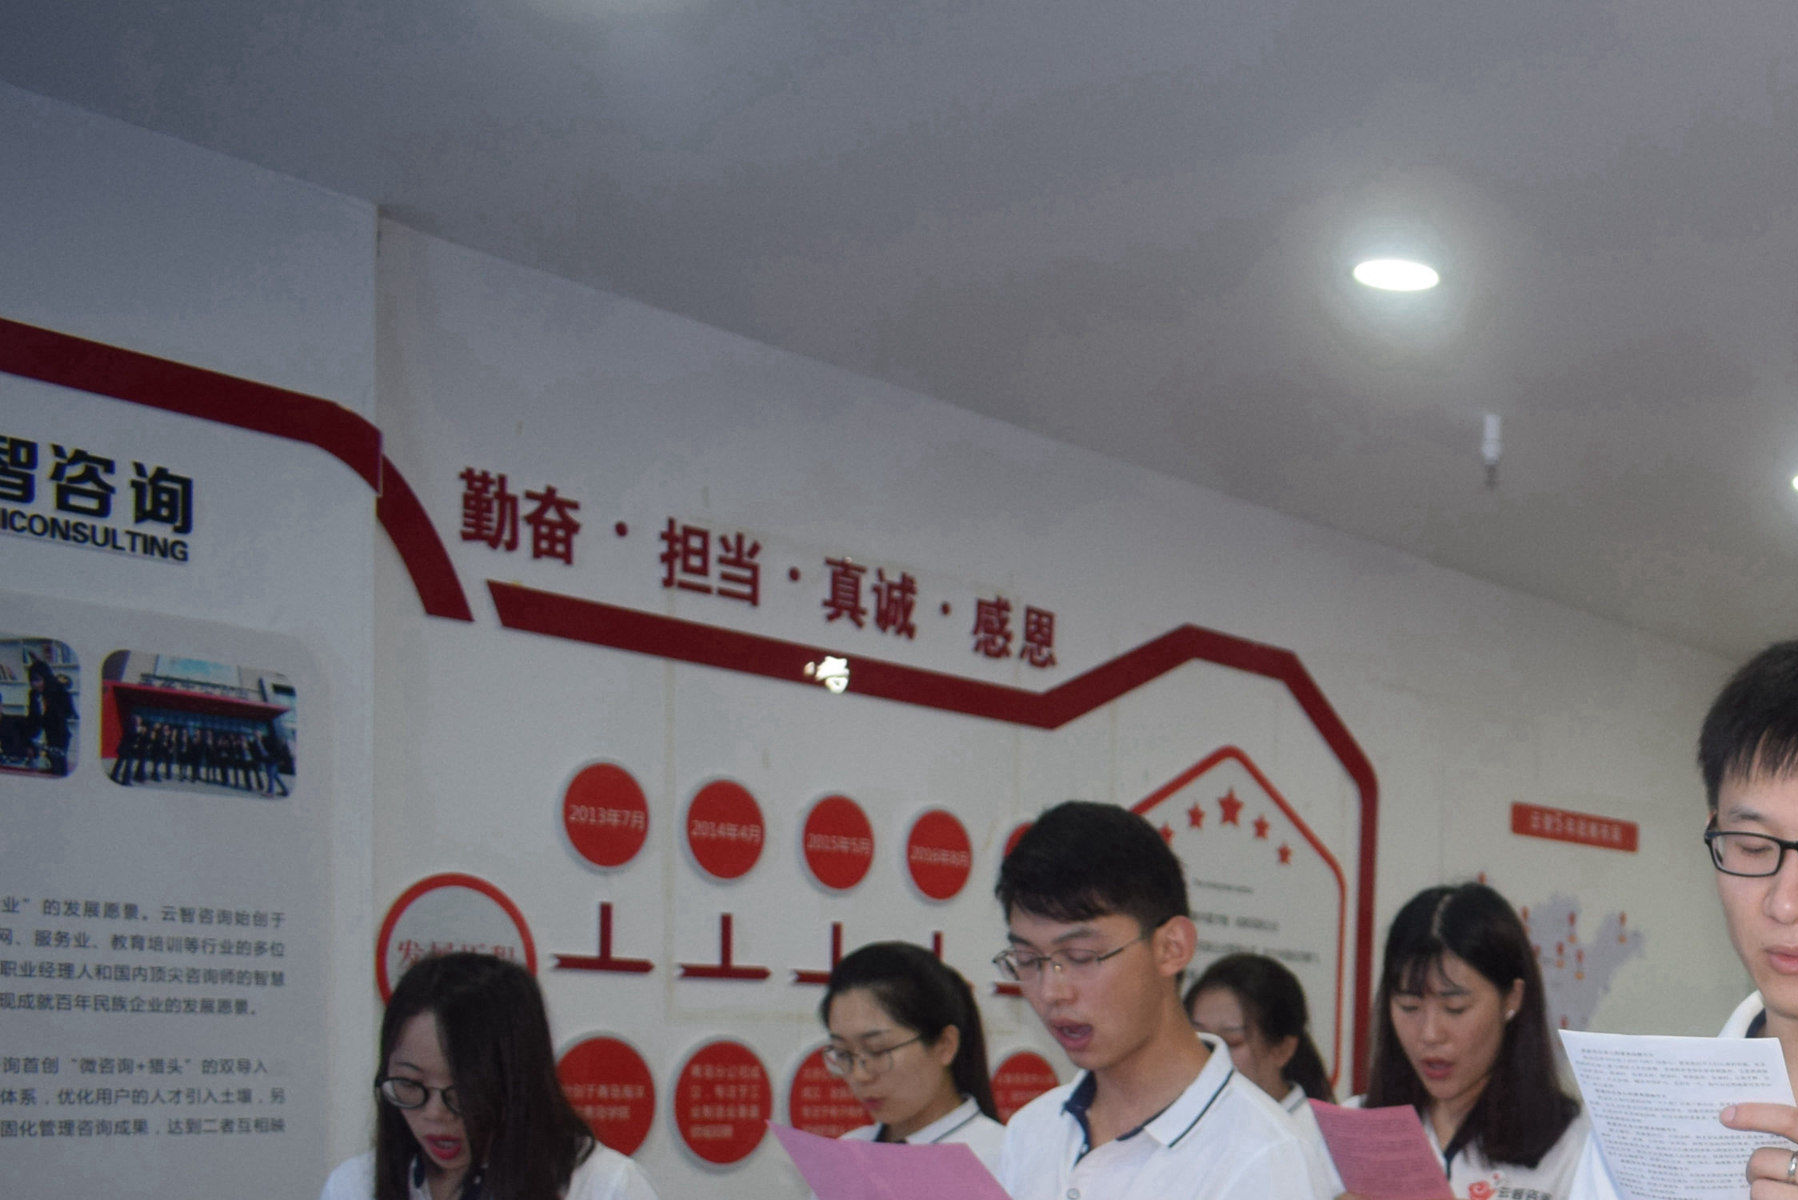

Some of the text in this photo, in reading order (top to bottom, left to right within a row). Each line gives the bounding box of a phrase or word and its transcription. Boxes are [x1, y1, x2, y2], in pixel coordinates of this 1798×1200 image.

[0, 434, 193, 535] 智咨询
[569, 804, 645, 831] 2013年7月
